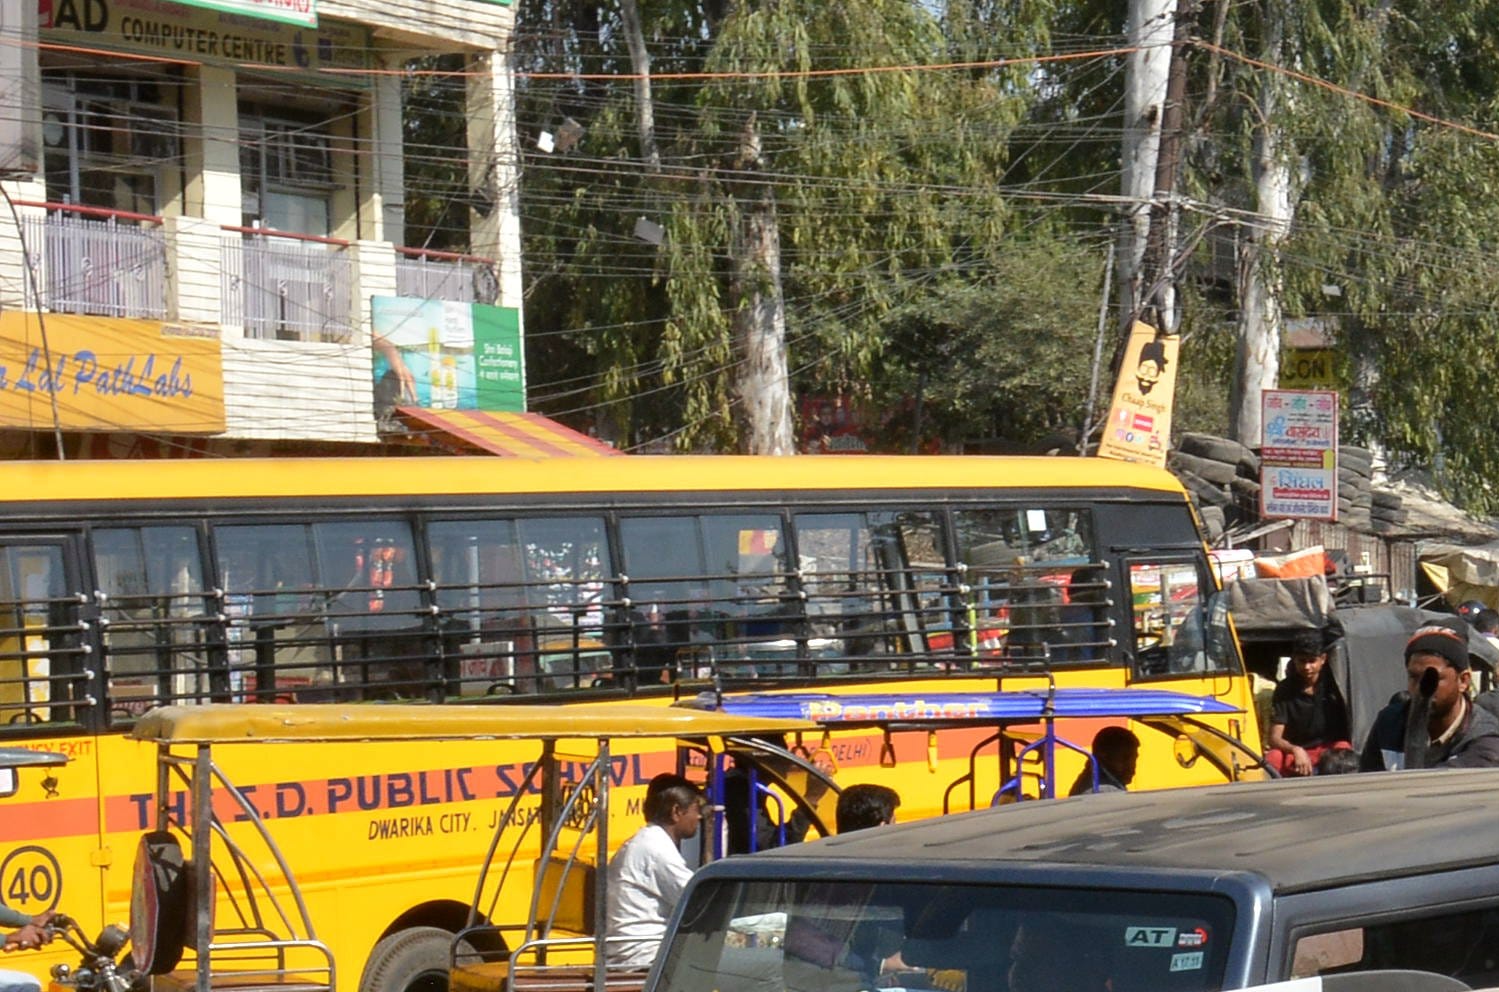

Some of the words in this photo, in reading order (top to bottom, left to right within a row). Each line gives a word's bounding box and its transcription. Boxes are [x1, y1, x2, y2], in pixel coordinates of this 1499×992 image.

[120, 16, 218, 55] COMPUTER
[222, 34, 286, 66] CENTRE
[15, 347, 65, 393] Lal
[72, 350, 193, 398] PathLabs
[59, 741, 92, 757] EXIT
[327, 767, 476, 814] PUBLIC
[368, 814, 433, 841] DWARIKA
[8, 864, 53, 905] 40
[1130, 929, 1169, 944] AT
